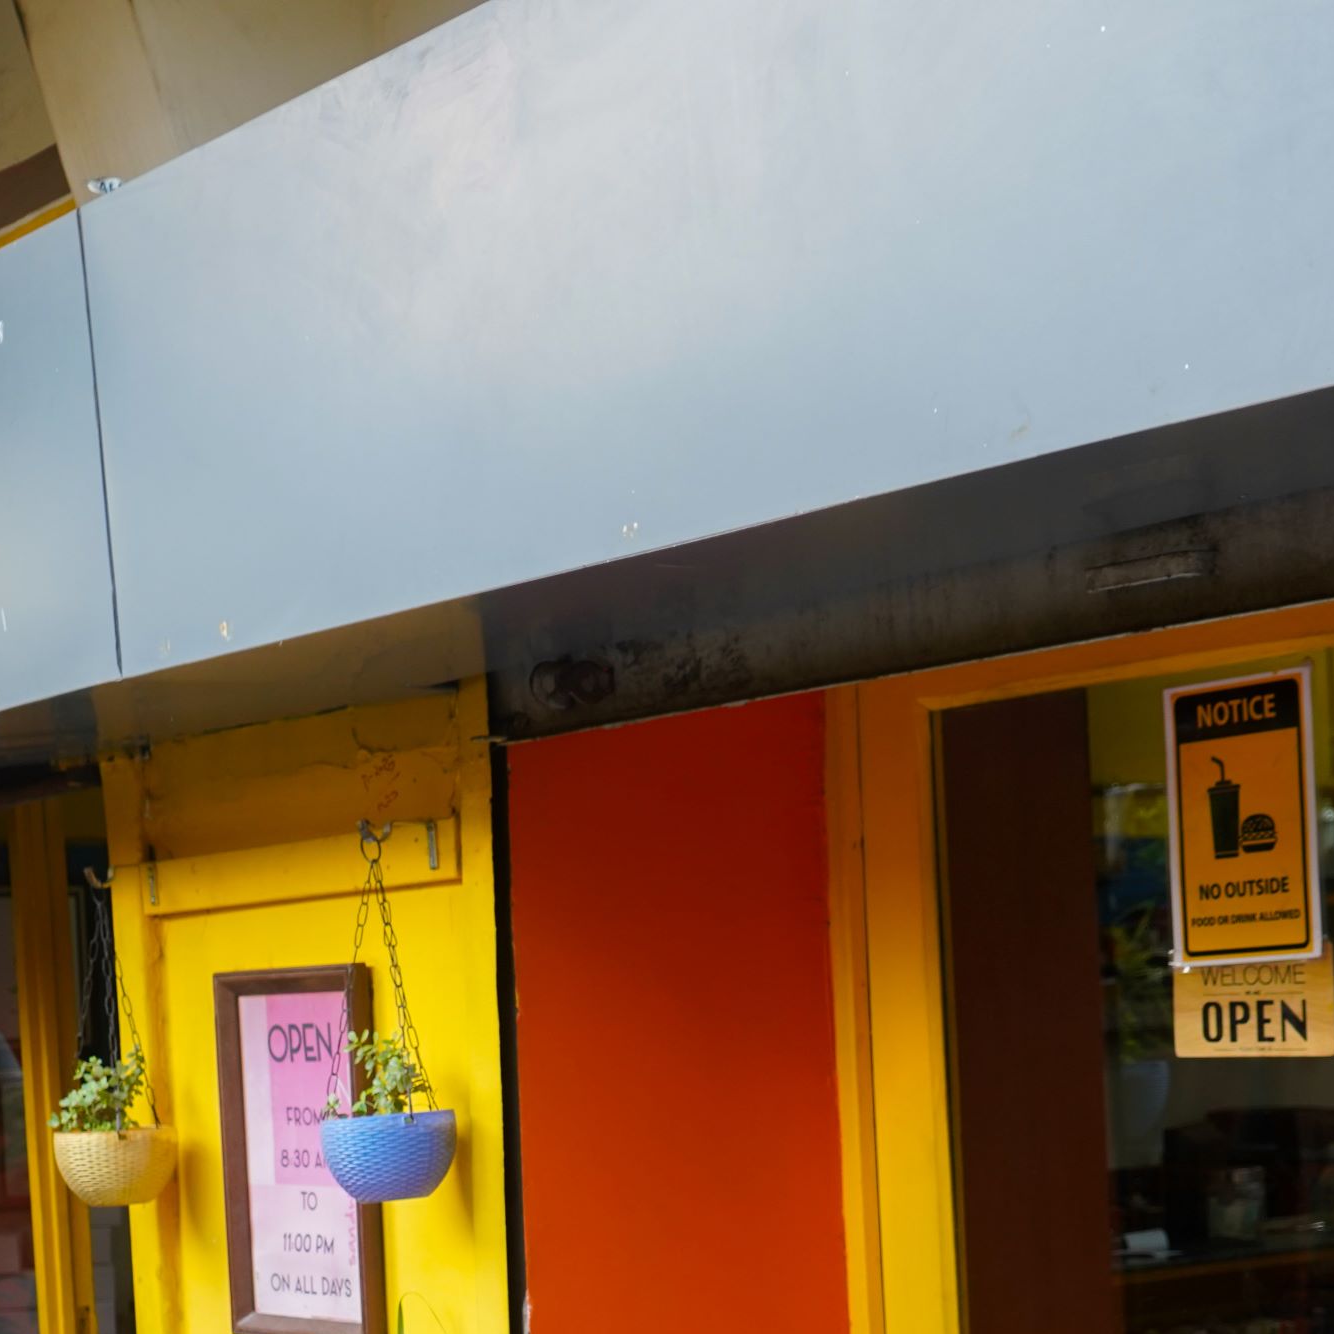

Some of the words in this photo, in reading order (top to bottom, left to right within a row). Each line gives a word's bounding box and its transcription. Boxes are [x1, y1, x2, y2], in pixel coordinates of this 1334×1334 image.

[1196, 693, 1277, 728] NOTICE
[1199, 883, 1221, 901] NO
[1225, 876, 1290, 898] OUTSIDE
[1192, 916, 1216, 927] FOOD
[1217, 914, 1229, 925] OR
[1231, 912, 1258, 924] DRINK
[1259, 908, 1301, 921] ALLOWED
[1200, 963, 1307, 986] WELCOME
[1202, 999, 1308, 1043] OPEN
[267, 1022, 333, 1063] OPEN
[301, 1191, 318, 1211] TO
[315, 1234, 335, 1256] PM
[270, 1272, 291, 1293] ON
[294, 1274, 318, 1296] ALL
[321, 1276, 353, 1298] DAYS
